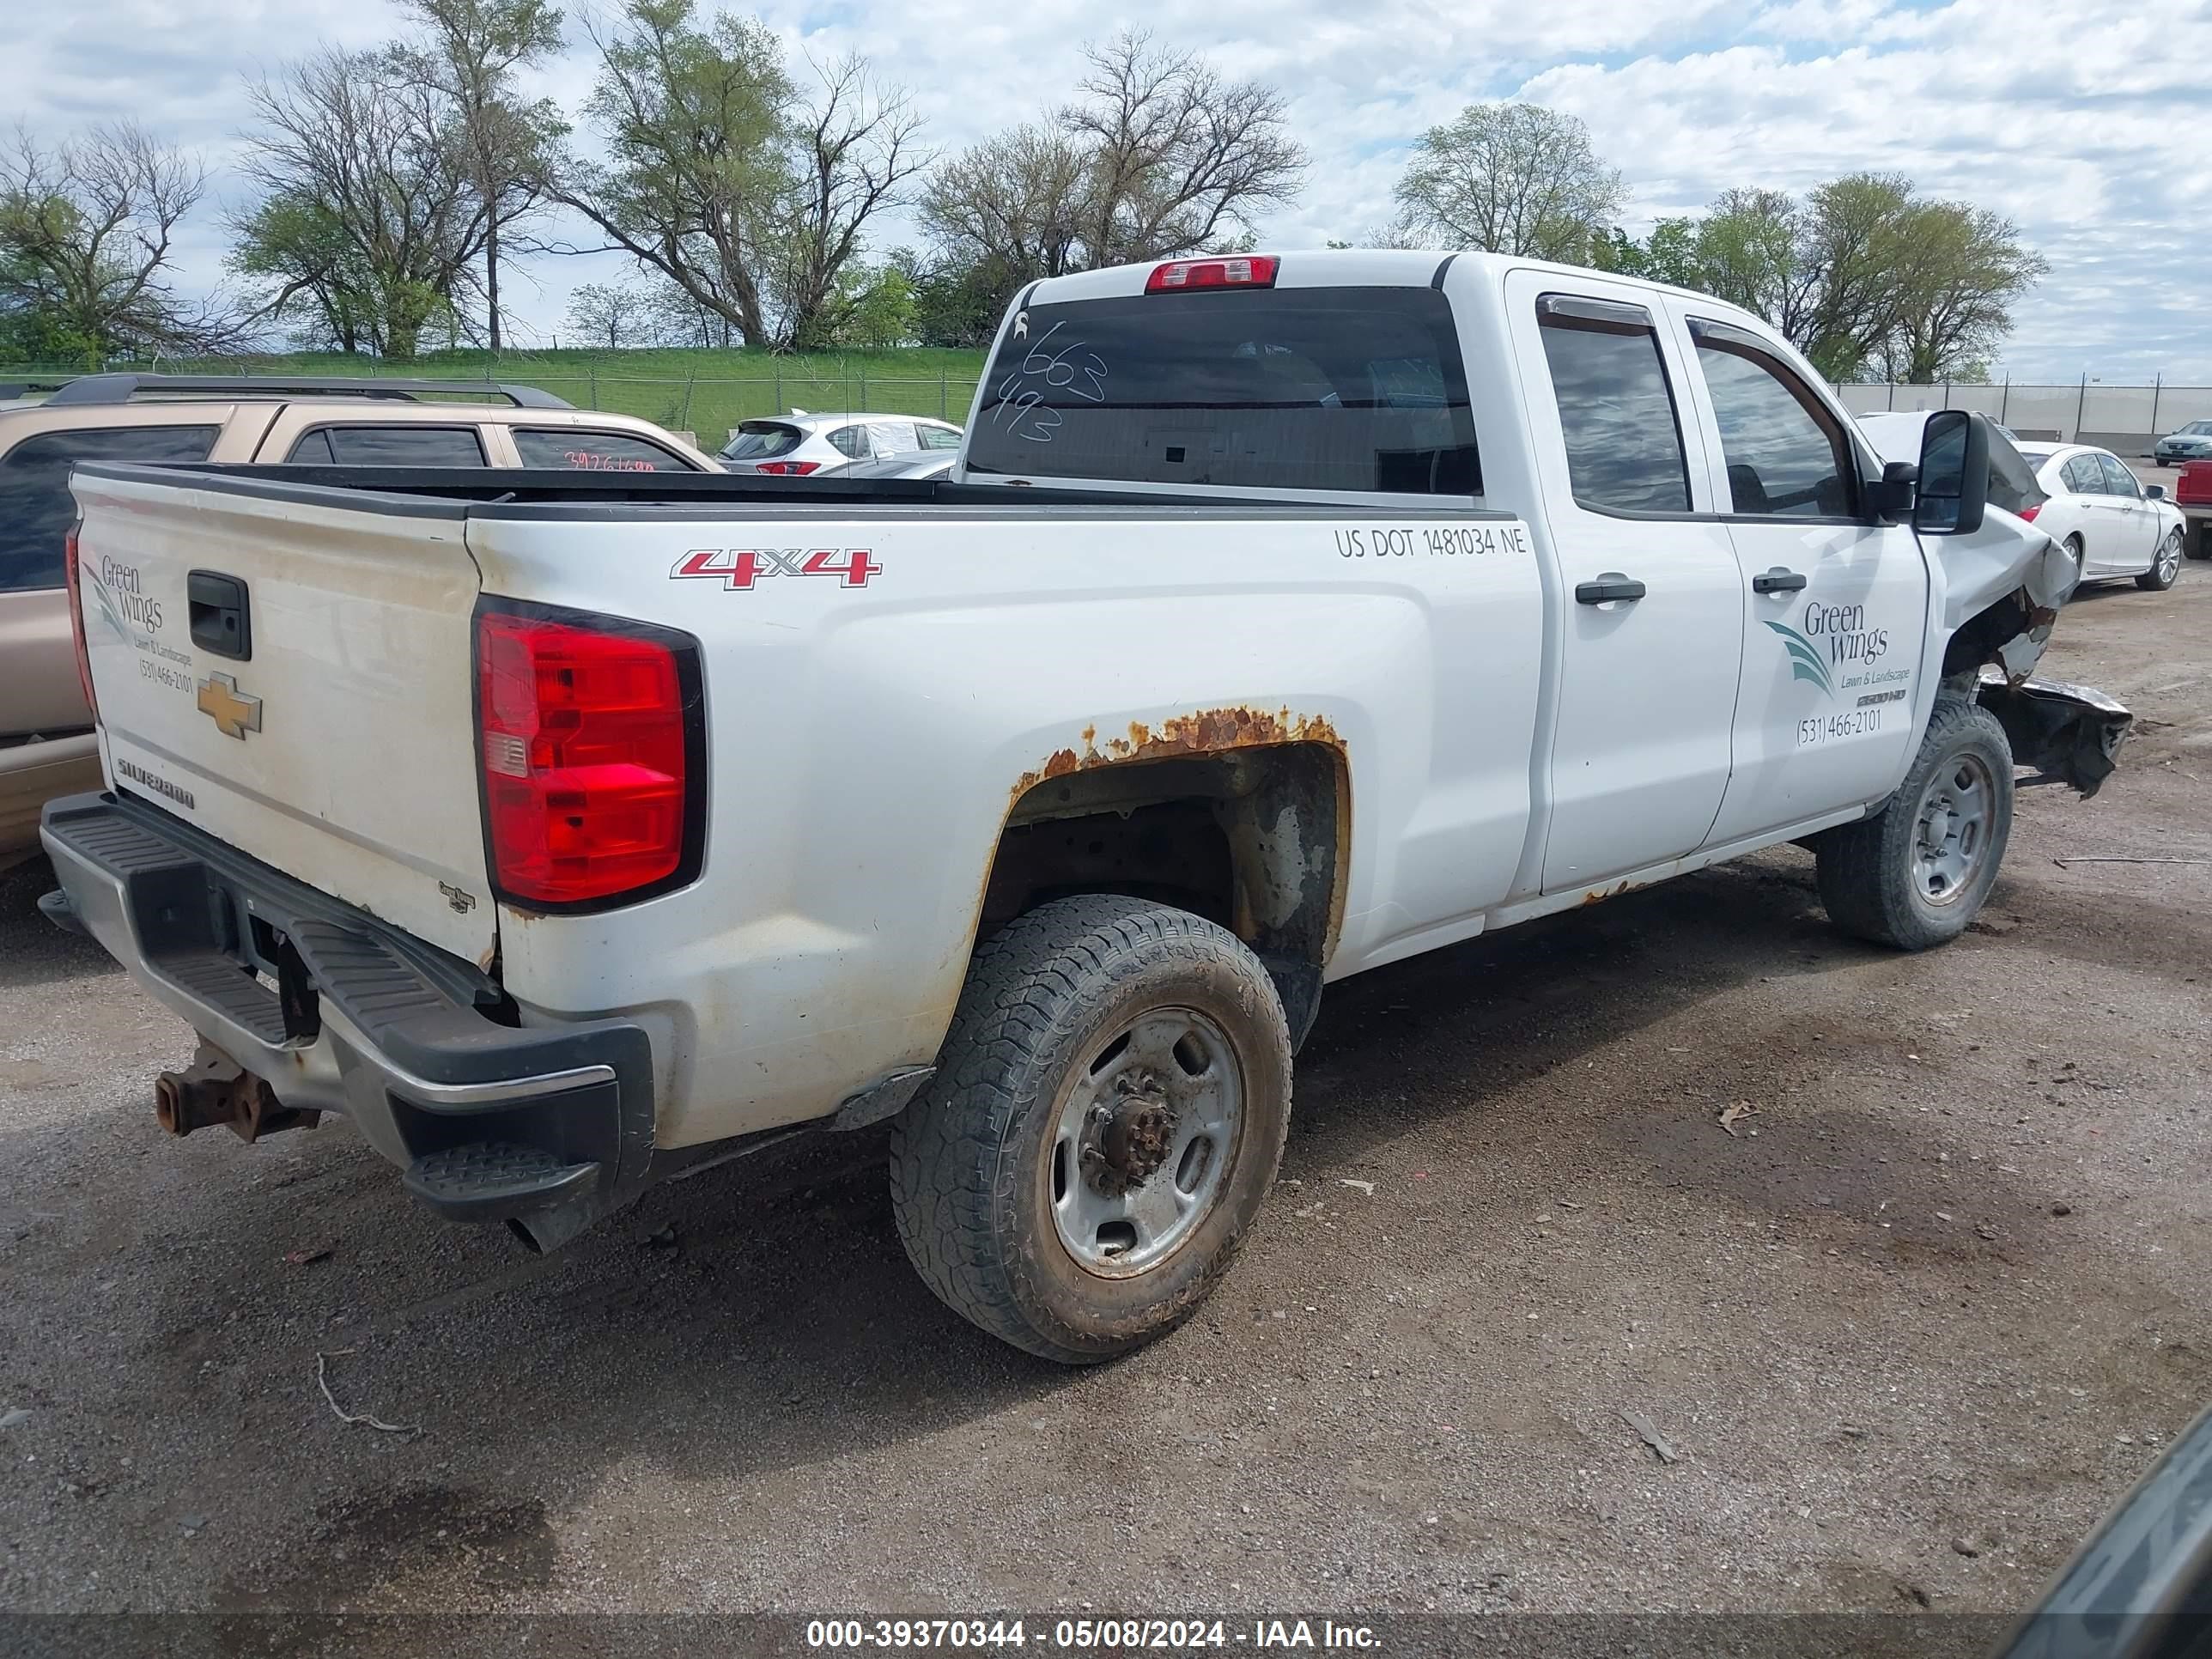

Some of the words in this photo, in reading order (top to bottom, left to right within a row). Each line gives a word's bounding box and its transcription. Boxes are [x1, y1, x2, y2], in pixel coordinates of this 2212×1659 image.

[1023, 320, 1108, 402] 663
[993, 373, 1063, 442] 493
[1334, 529, 1365, 558] US
[1371, 529, 1414, 557] DOT
[1422, 528, 1496, 556] 1481034
[1499, 528, 1527, 554] NE
[102, 555, 140, 594] Green
[118, 592, 162, 634] Wings
[1804, 602, 1864, 636] Green
[1830, 628, 1888, 667] Wings
[1841, 675, 1863, 689] Lawn
[1863, 672, 1870, 685] &
[1872, 668, 1911, 684] Landscape
[118, 758, 195, 810] SILVERADO
